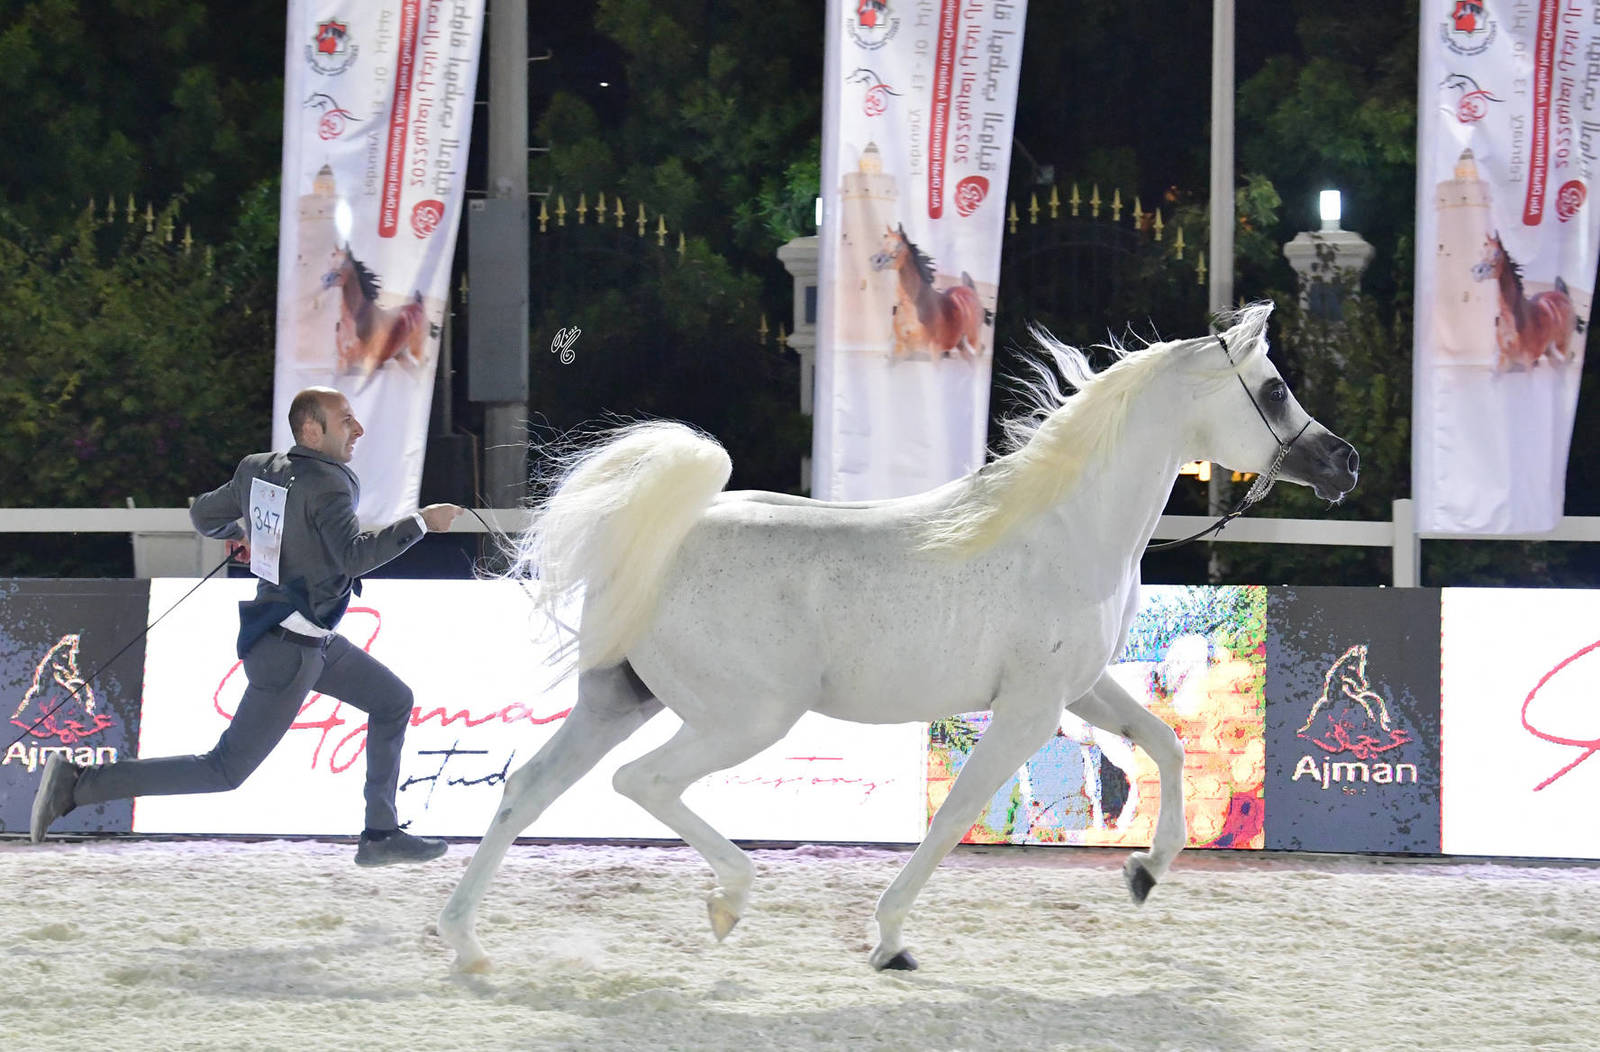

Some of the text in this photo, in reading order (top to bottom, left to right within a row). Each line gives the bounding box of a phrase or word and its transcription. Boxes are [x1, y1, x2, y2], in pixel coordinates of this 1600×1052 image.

[253, 506, 280, 535] 347
[1, 741, 118, 772] Ajman
[1291, 755, 1417, 789] Ajman
